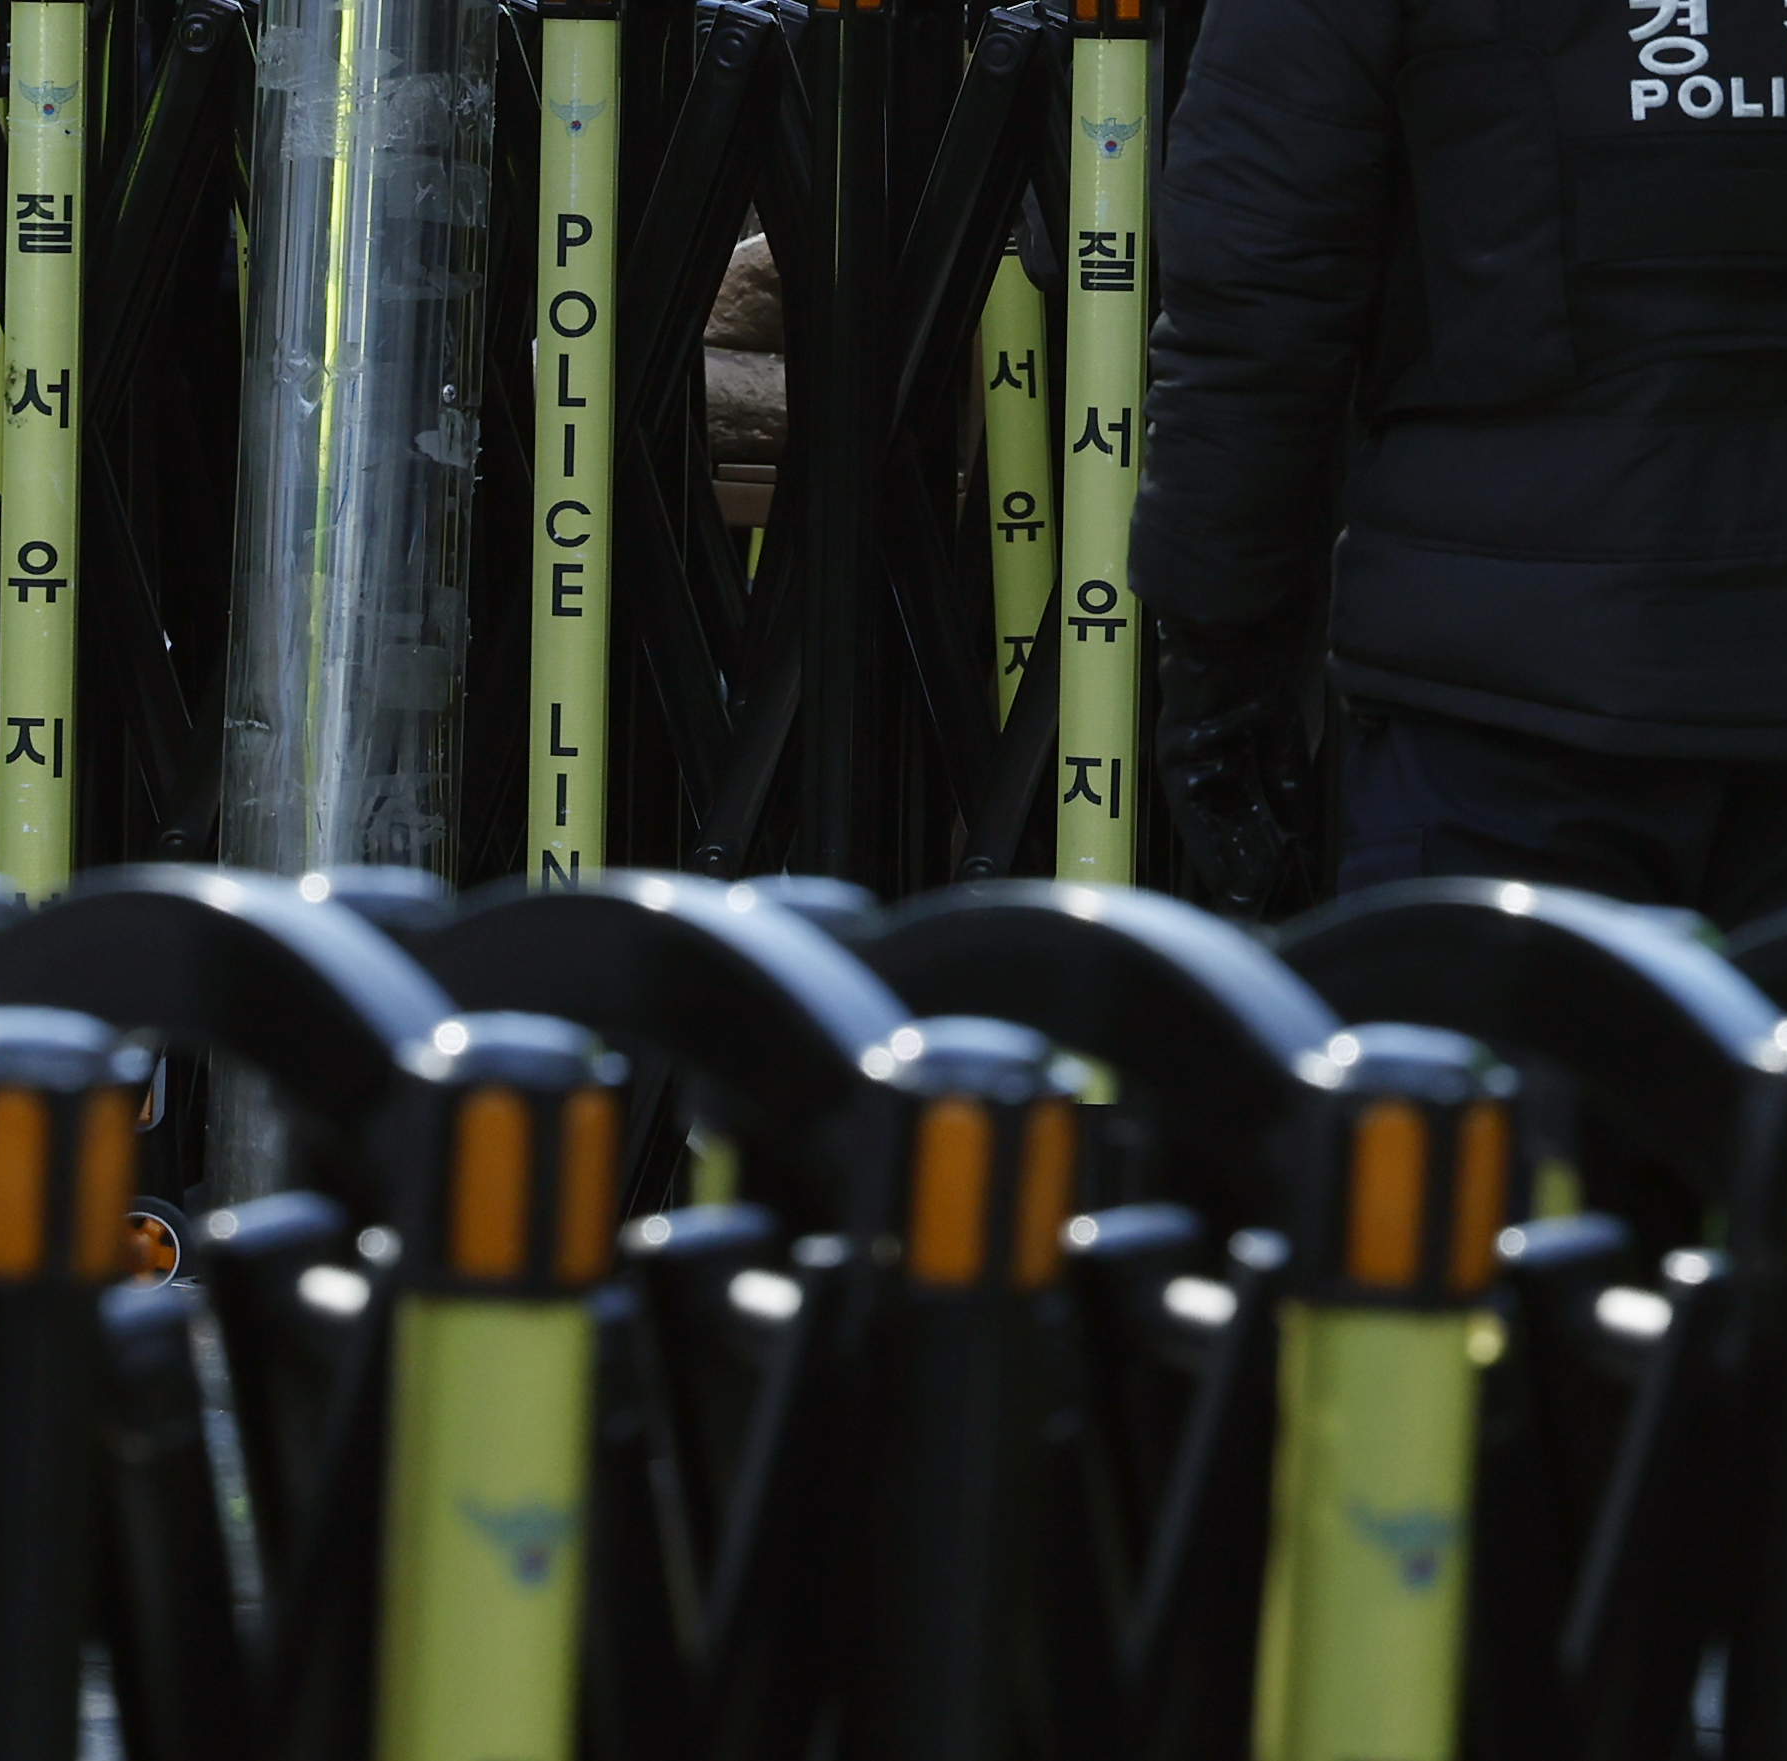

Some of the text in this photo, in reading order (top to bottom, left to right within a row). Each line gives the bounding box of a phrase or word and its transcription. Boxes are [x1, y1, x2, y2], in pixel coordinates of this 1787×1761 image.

[5, 194, 74, 910] 질서유지
[545, 214, 597, 618] POLICE
[1063, 230, 1137, 819] 질서유지
